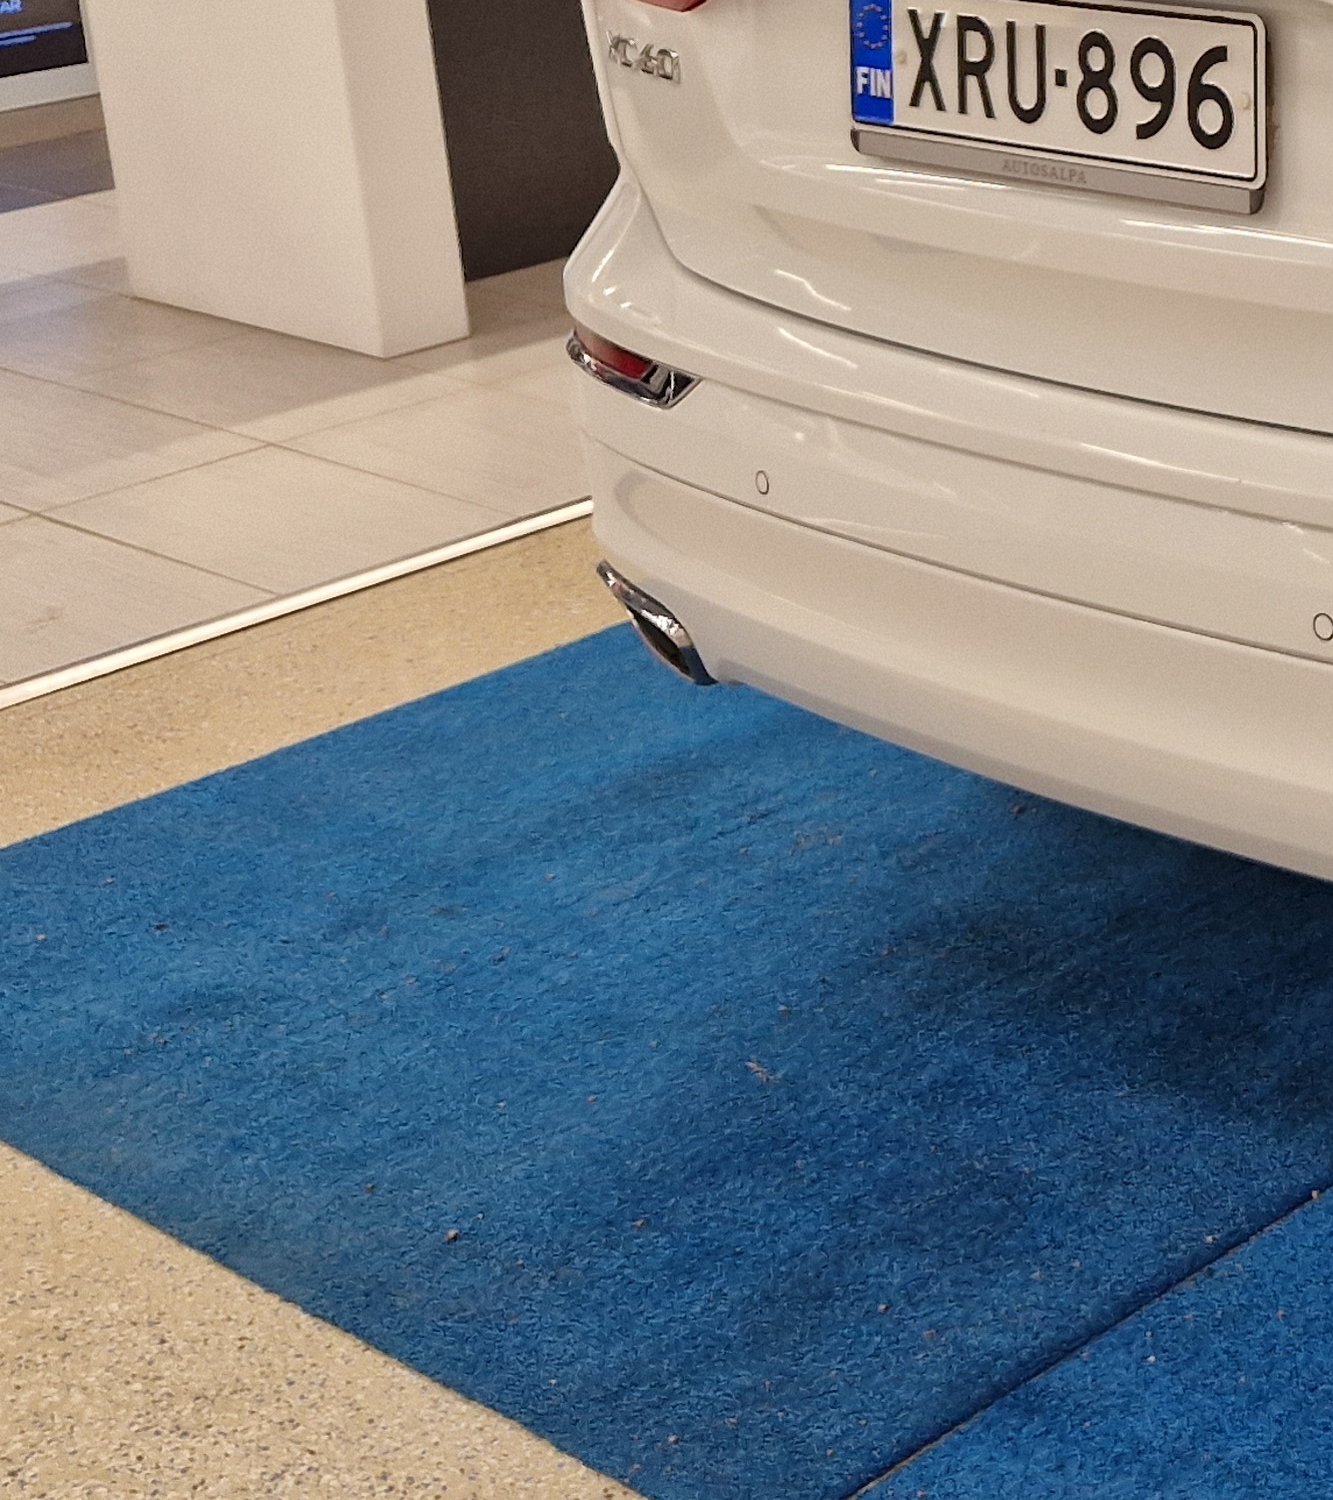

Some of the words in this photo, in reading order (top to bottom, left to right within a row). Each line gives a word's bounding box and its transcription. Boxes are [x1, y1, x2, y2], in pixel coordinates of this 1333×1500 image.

[605, 30, 681, 84] XC60
[855, 66, 893, 99] FIN
[907, 8, 1235, 150] XRU-896
[1000, 159, 1087, 184] AUTOSALPA
